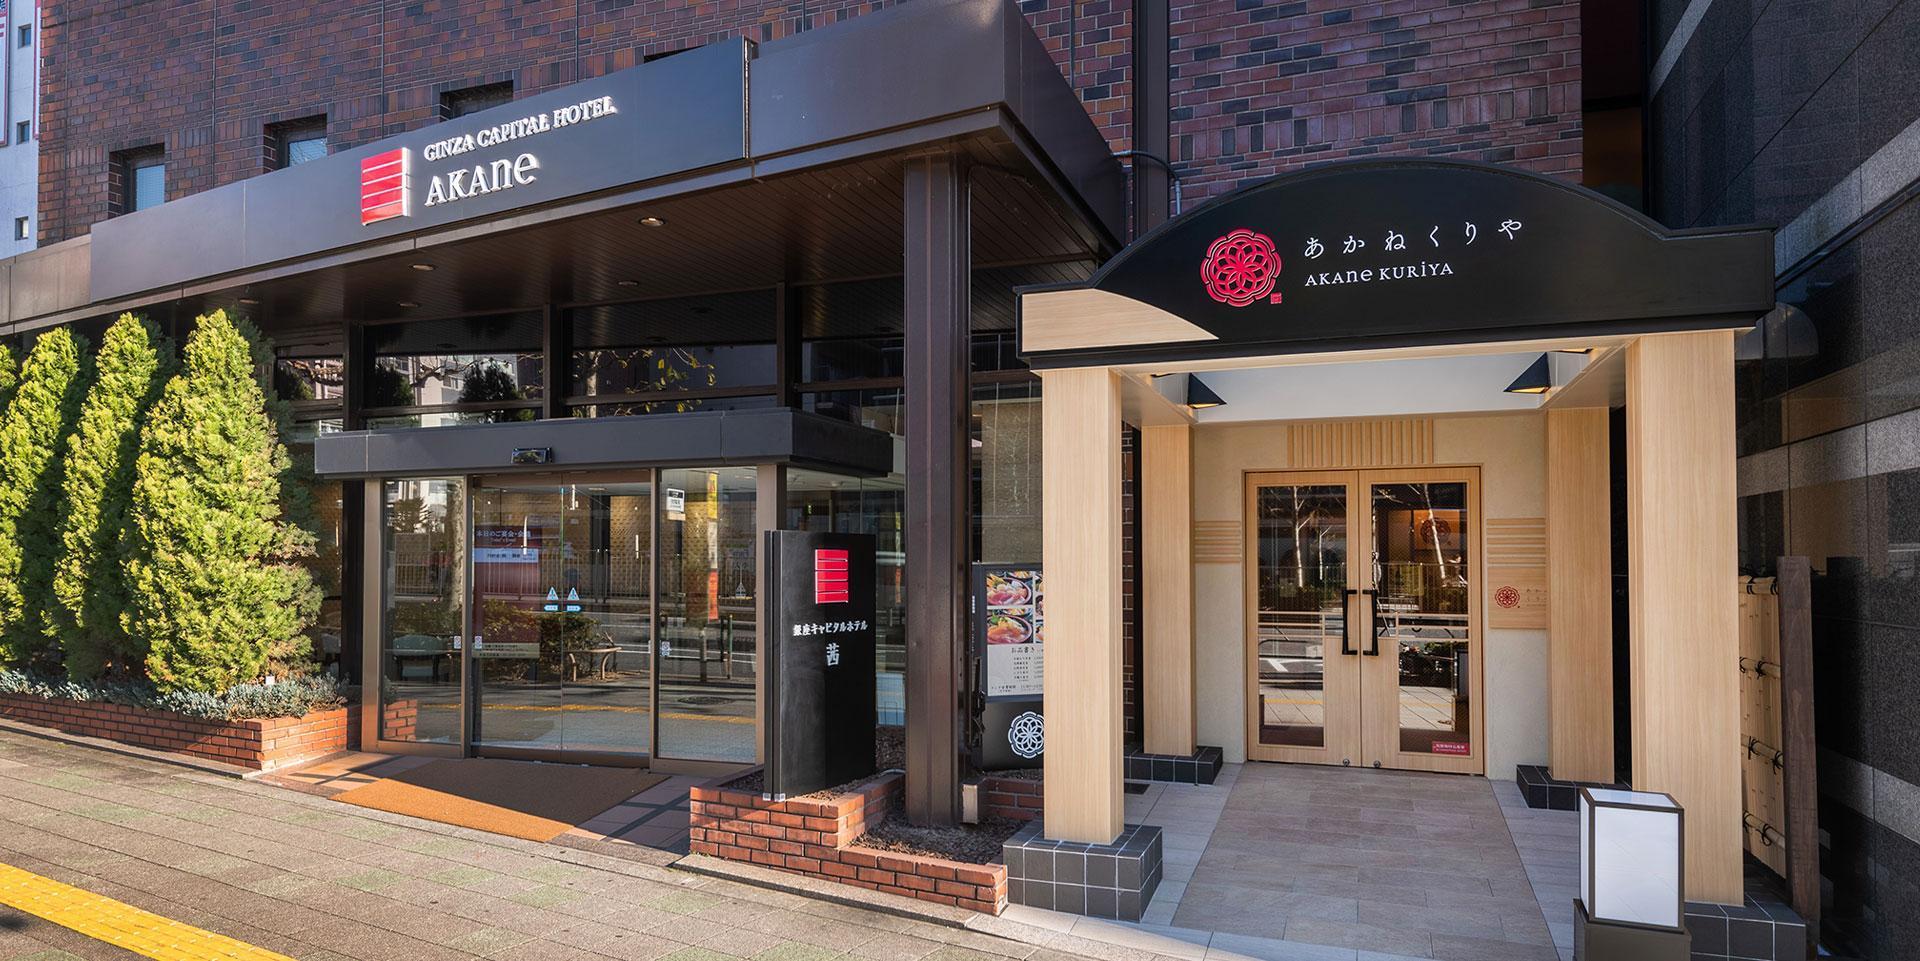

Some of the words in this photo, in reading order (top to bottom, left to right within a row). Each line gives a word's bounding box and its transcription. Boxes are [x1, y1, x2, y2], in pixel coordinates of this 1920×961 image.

[424, 134, 475, 161] GINZA
[477, 113, 550, 147] CAPITAL
[553, 96, 618, 129] HOTEL
[1304, 218, 1522, 259] あかねくりや
[793, 620, 868, 636] 銀座キャピタルホテル
[826, 642, 840, 666] 茜
